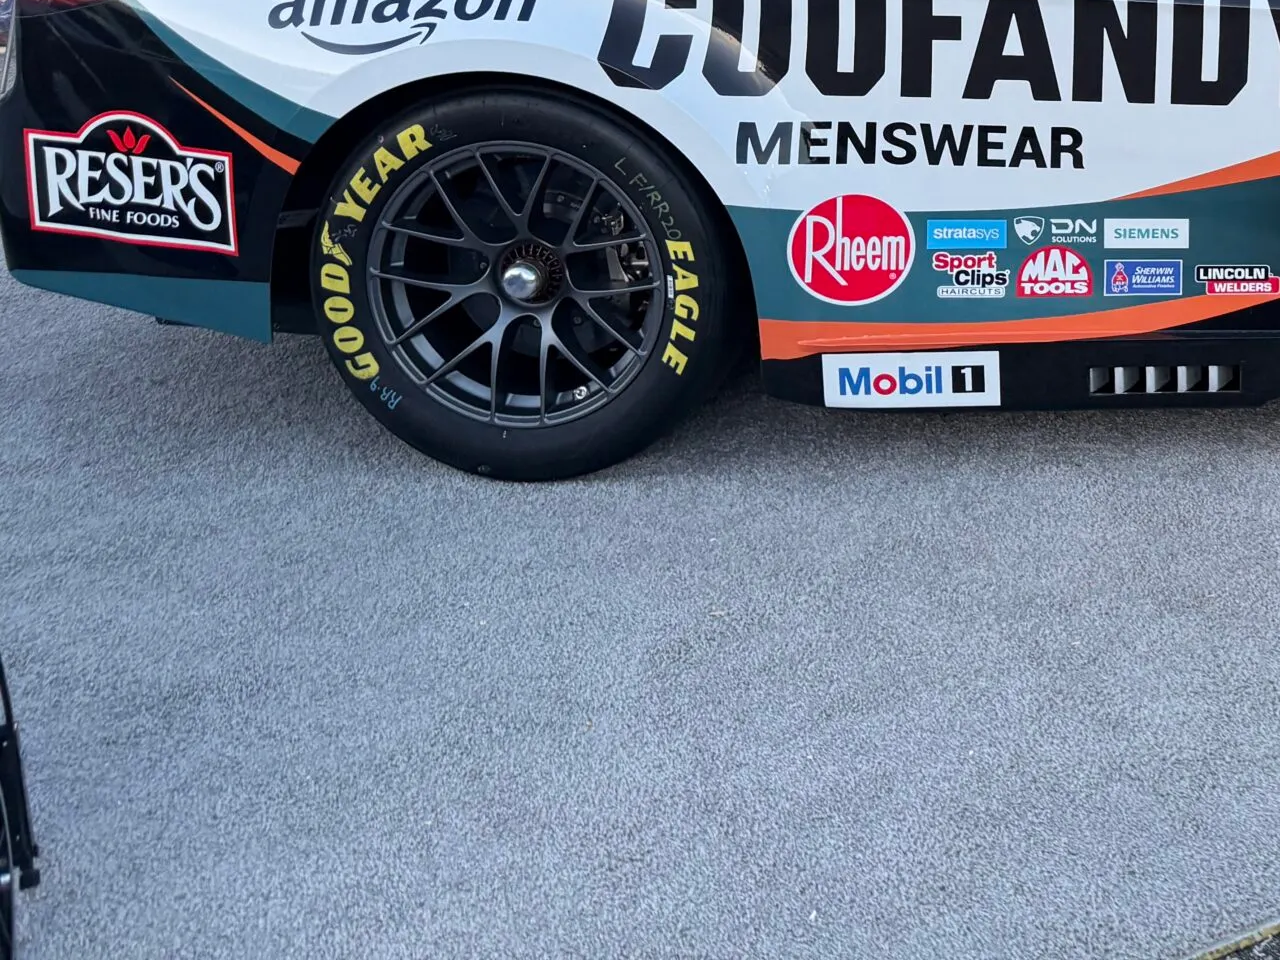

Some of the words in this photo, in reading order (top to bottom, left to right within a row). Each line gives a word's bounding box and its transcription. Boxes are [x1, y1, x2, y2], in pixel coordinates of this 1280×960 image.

[735, 120, 1086, 170] MENSWEAR
[44, 145, 223, 231] RESER'S
[89, 206, 120, 224] FINE
[126, 210, 180, 229] FOODS
[1051, 217, 1097, 234] DN
[804, 198, 906, 286] Rheem
[933, 225, 1000, 242] stratasys
[1051, 235, 1097, 243] SOLUTIONS
[1113, 227, 1180, 240] SIEMENS
[933, 251, 995, 273] Sport
[1022, 248, 1089, 282] MAC
[1134, 266, 1174, 275] SHERWIN
[955, 269, 1008, 289] Clips
[1199, 267, 1265, 280] LINCOLN
[940, 288, 1002, 296] HAIRCUTS
[1020, 282, 1089, 295] TOOLS
[1213, 282, 1273, 293] WELDERS
[661, 239, 700, 376] EAGLE
[838, 363, 944, 398] Mobil
